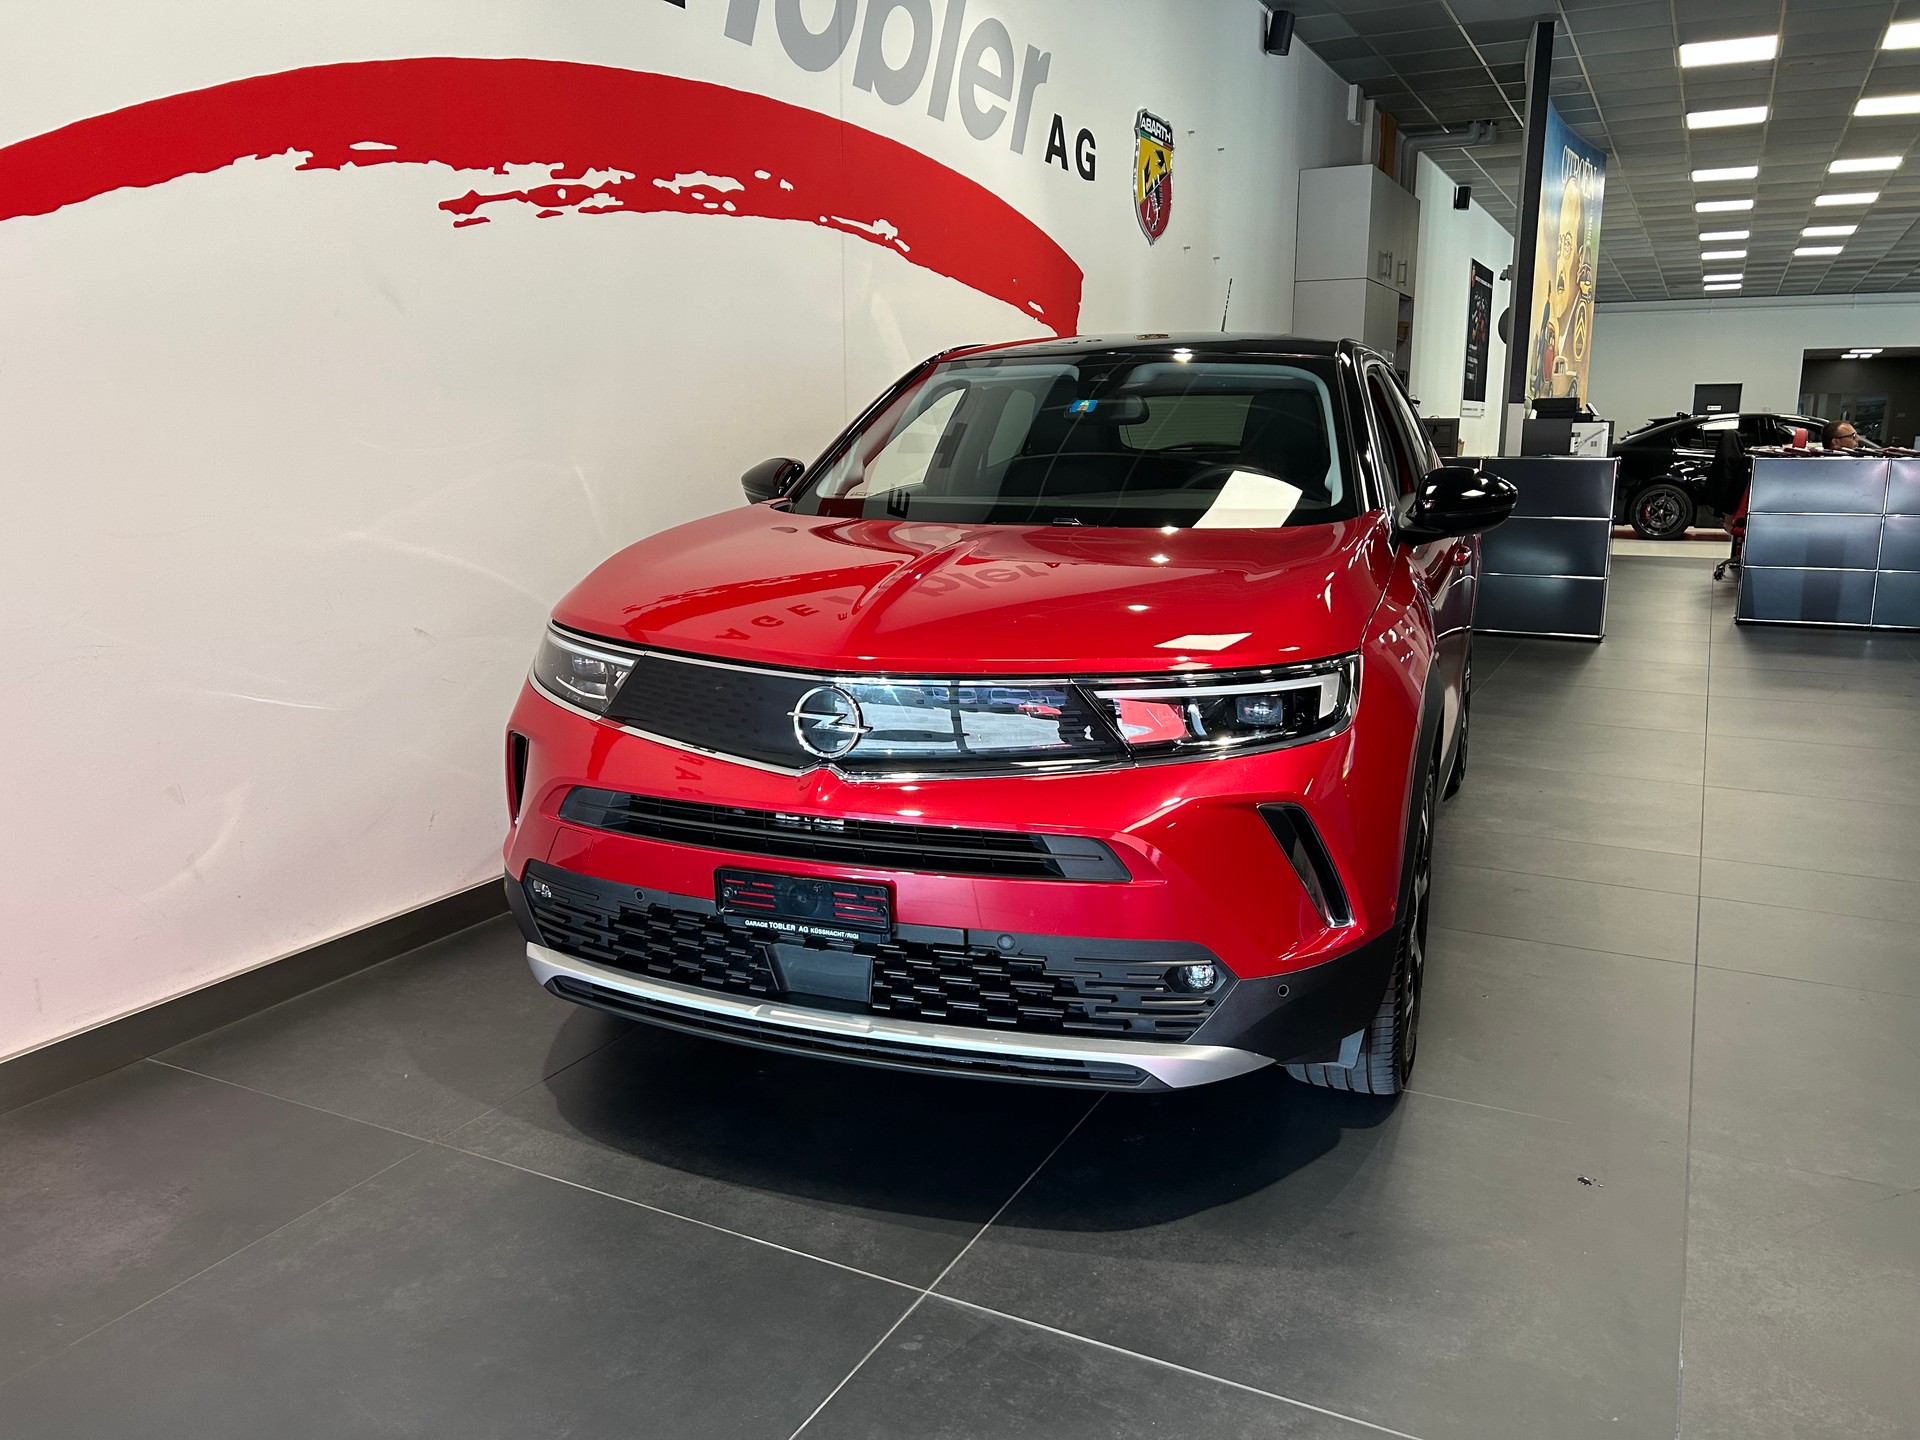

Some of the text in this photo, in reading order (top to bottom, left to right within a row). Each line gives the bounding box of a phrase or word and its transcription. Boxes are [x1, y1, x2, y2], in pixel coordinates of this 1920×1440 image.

[1140, 117, 1171, 143] ABARTH
[1044, 113, 1097, 182] AG
[745, 919, 769, 929] GARAGE
[769, 921, 796, 932] TOBLER
[798, 925, 809, 933] AG
